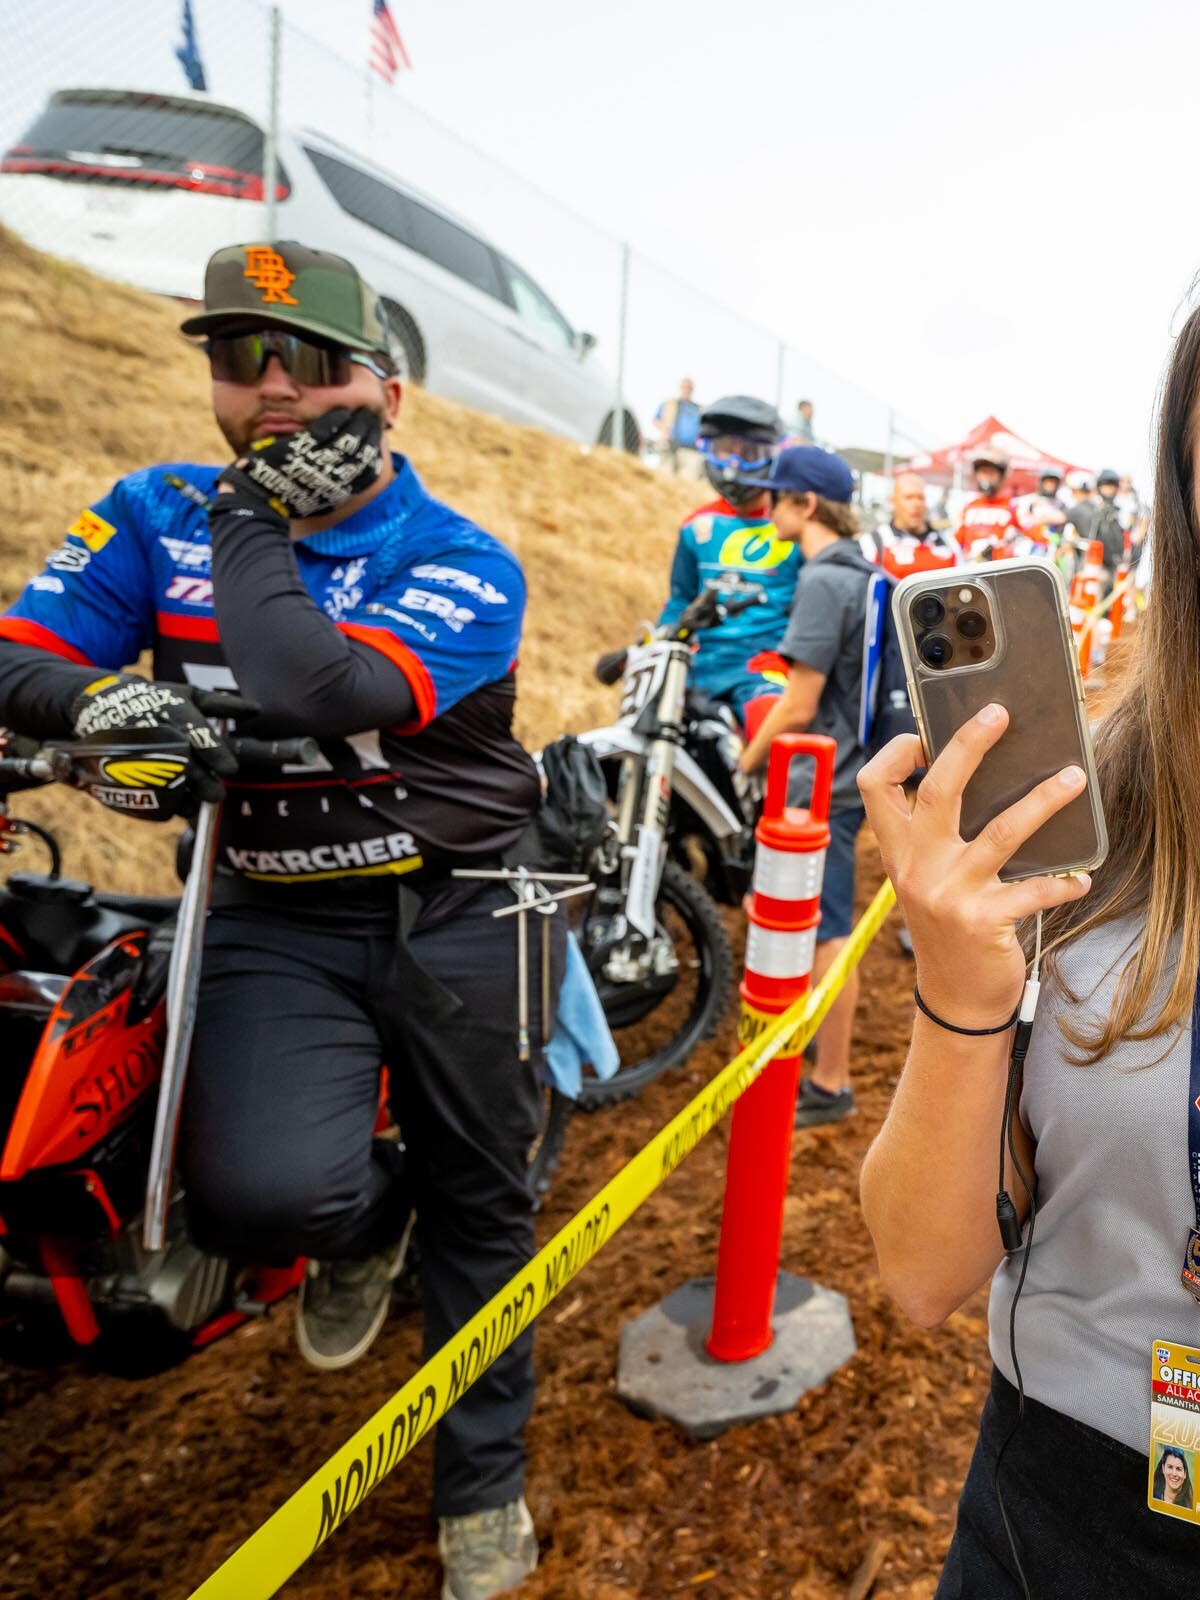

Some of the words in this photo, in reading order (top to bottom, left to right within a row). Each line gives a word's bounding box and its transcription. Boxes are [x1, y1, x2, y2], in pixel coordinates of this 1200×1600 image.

[541, 1203, 610, 1306] CAUTION
[443, 1282, 535, 1415] CAUTION
[1166, 1385, 1185, 1398] ALL
[1157, 1395, 1199, 1411] SAMANTHA
[314, 1384, 436, 1551] CAUTION
